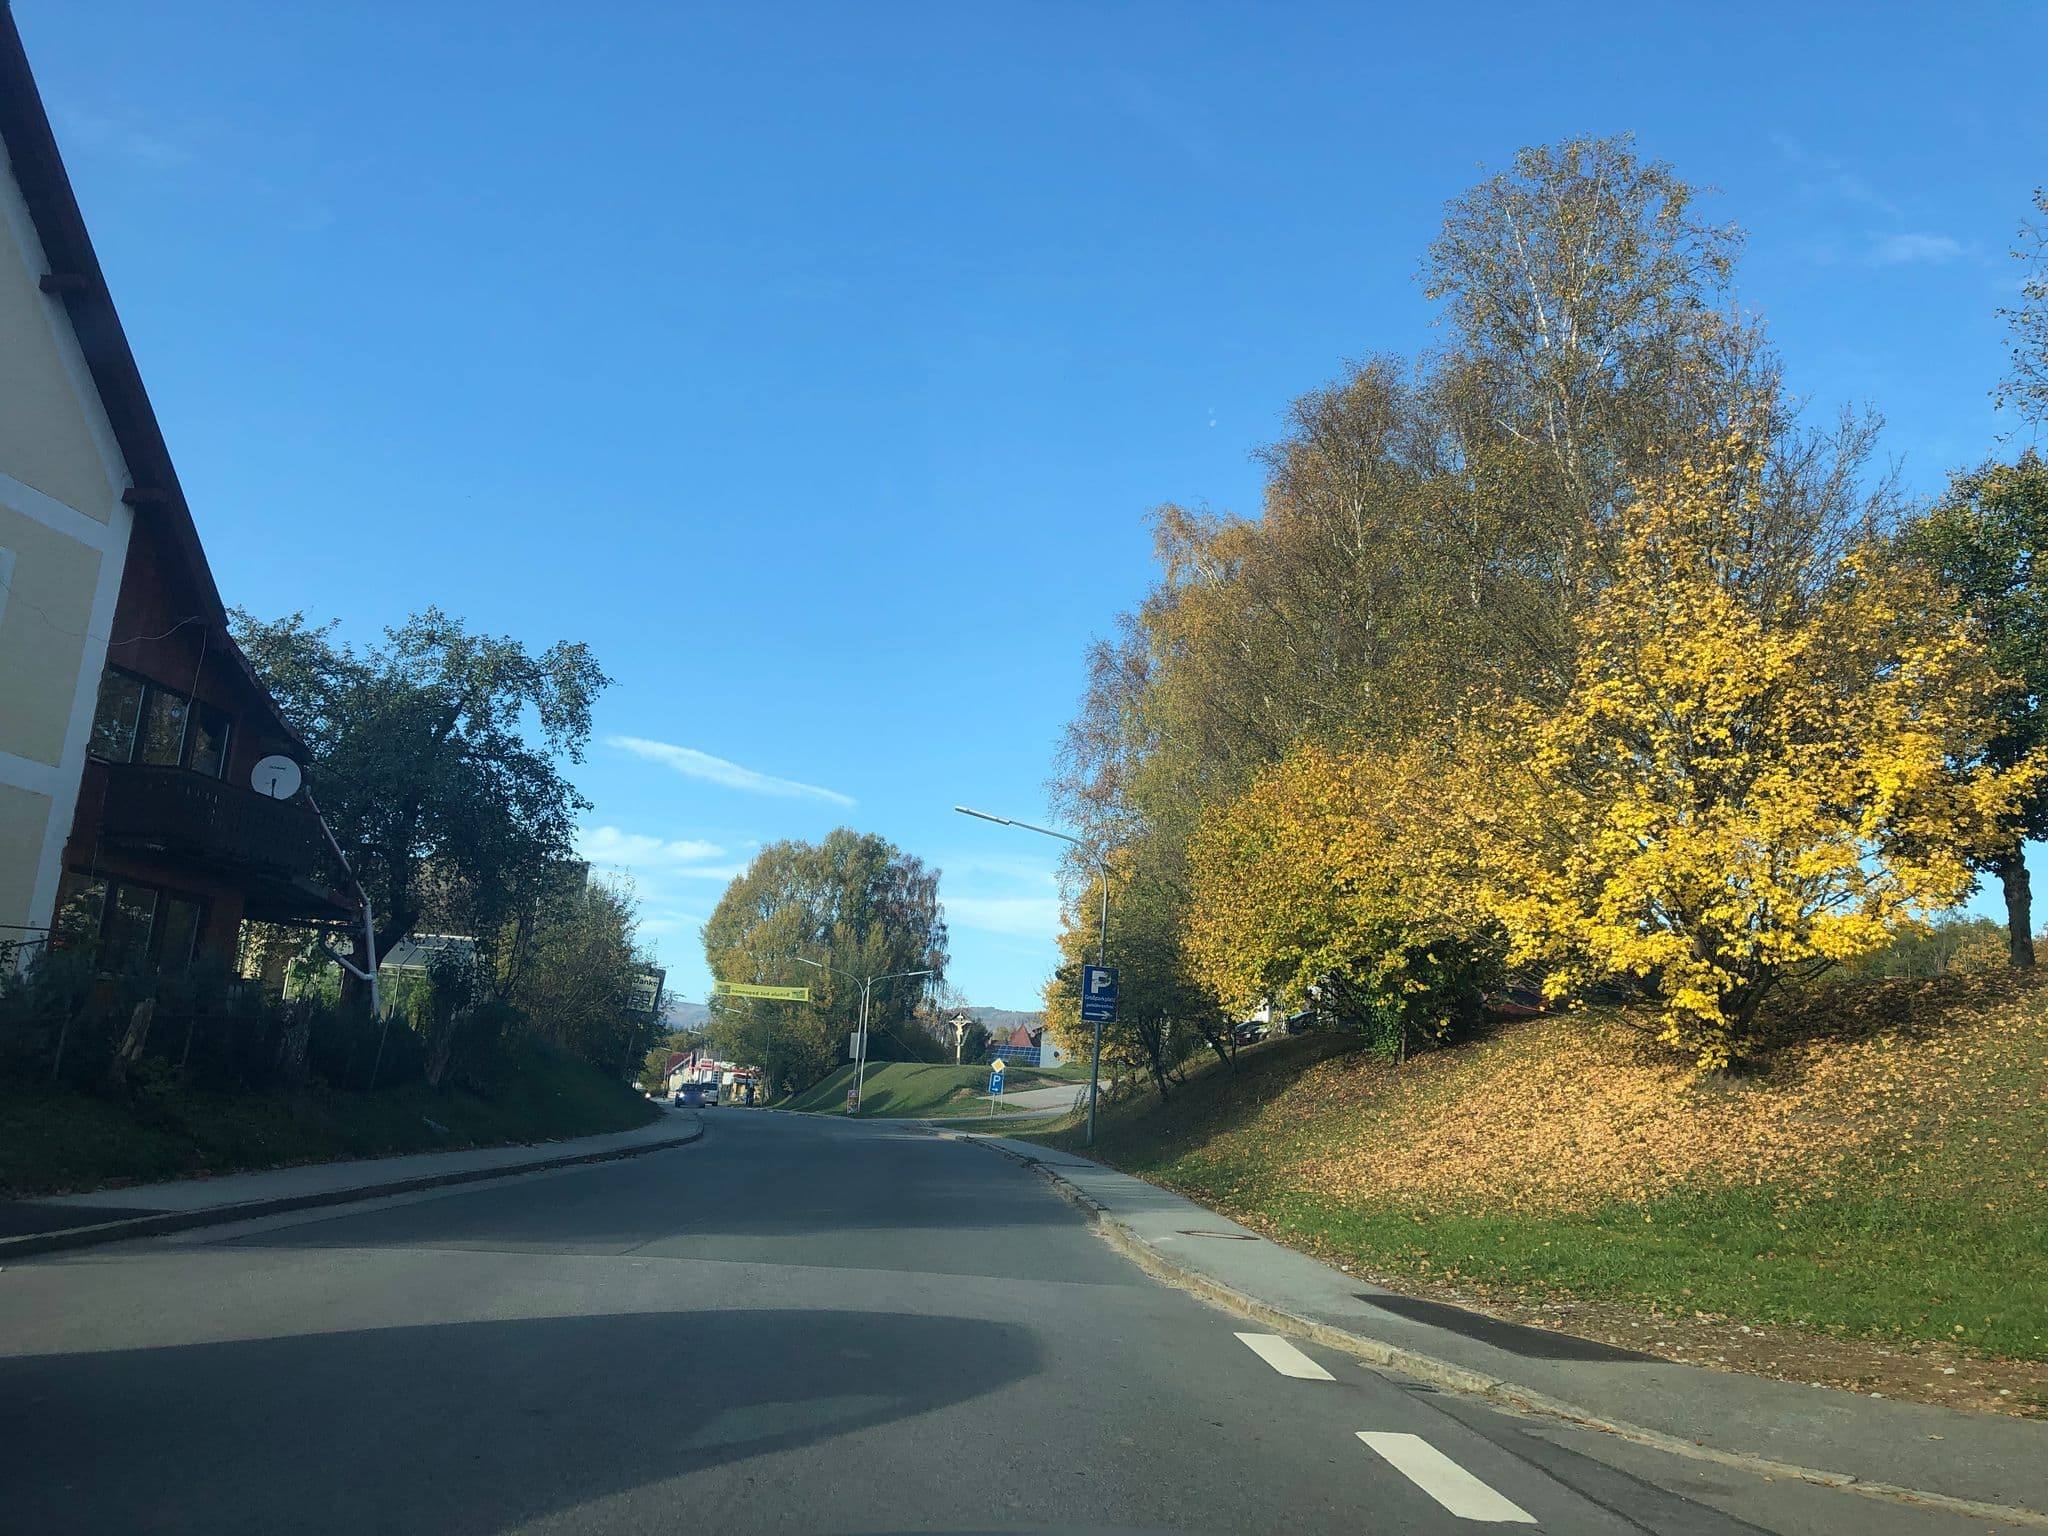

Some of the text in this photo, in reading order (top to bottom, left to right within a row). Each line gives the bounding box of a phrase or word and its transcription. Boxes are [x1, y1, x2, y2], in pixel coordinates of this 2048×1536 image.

[632, 976, 658, 986] Danke
[1091, 970, 1112, 993] P
[993, 1075, 1001, 1086] P
